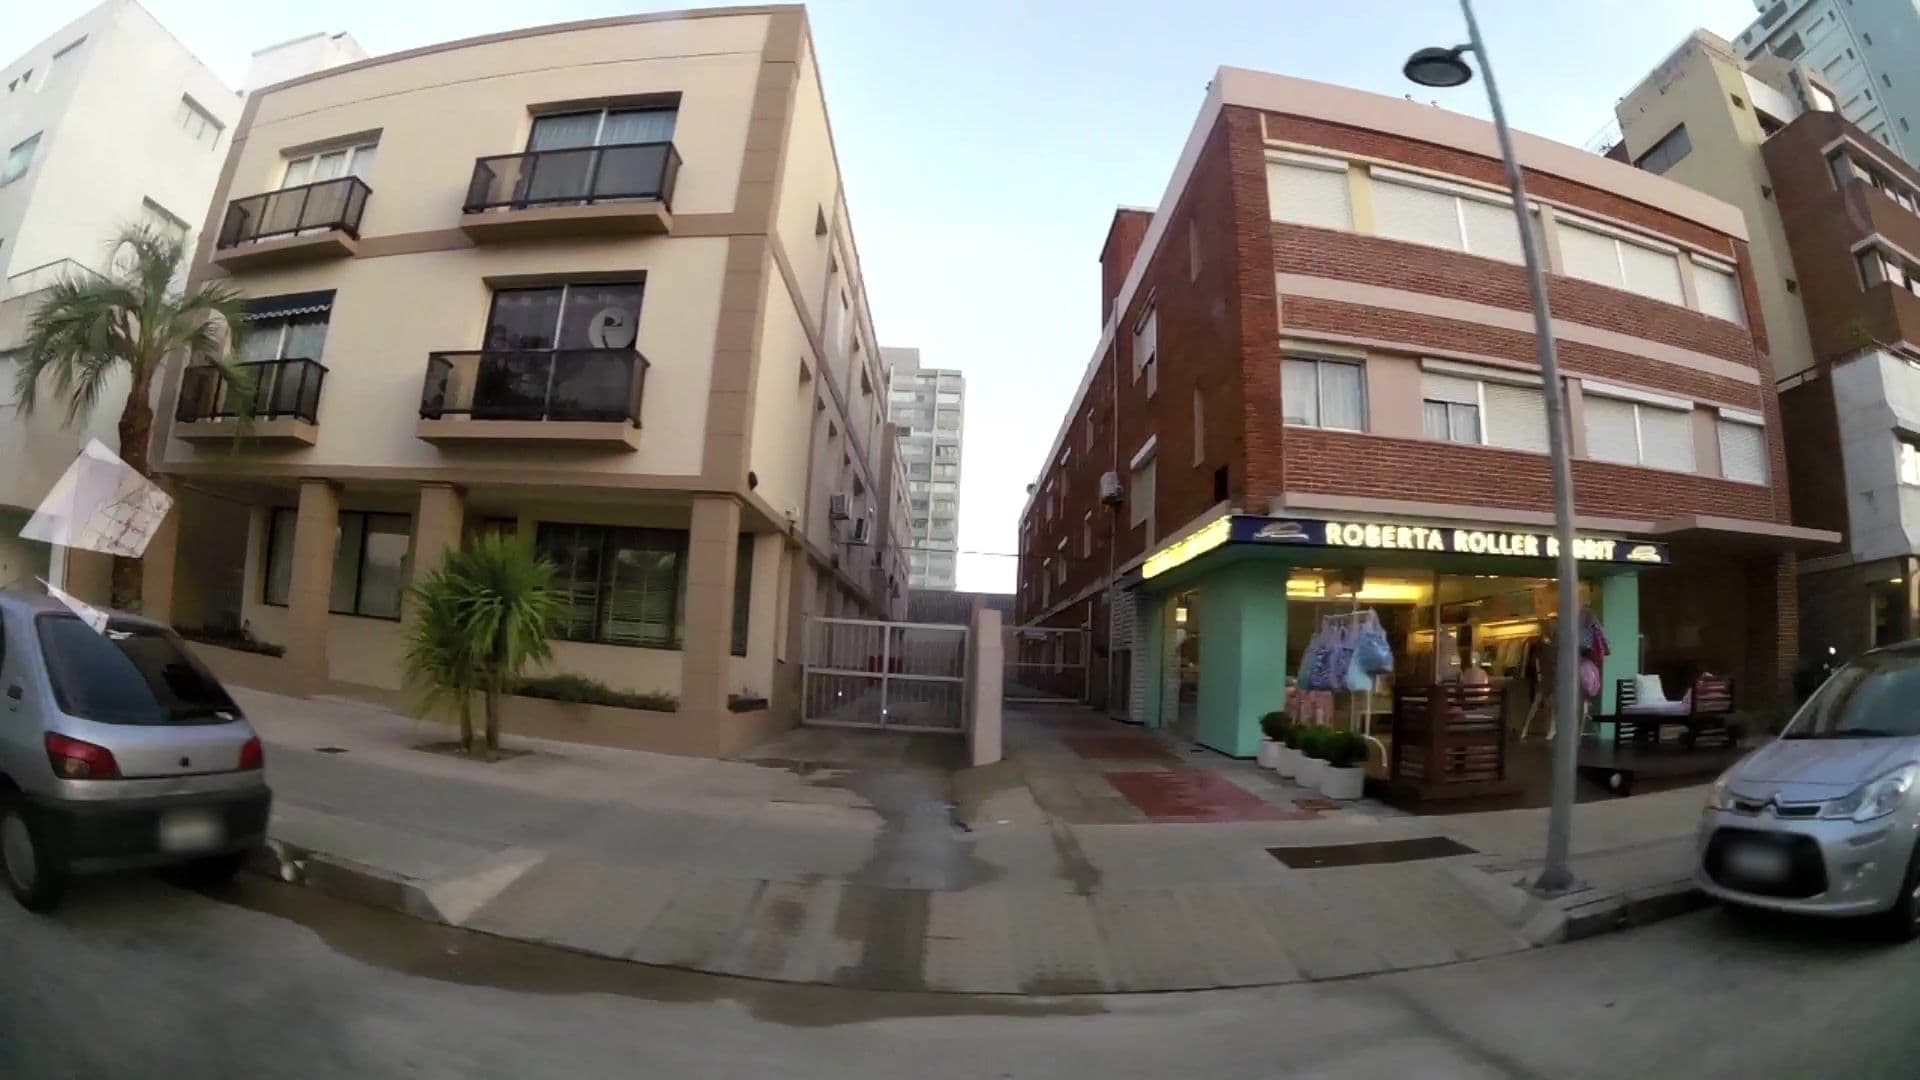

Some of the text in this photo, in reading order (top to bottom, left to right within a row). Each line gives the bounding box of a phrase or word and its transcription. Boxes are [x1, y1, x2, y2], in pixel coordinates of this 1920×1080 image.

[1325, 522, 1616, 560] ROBERTA ROLLER RBBIT
